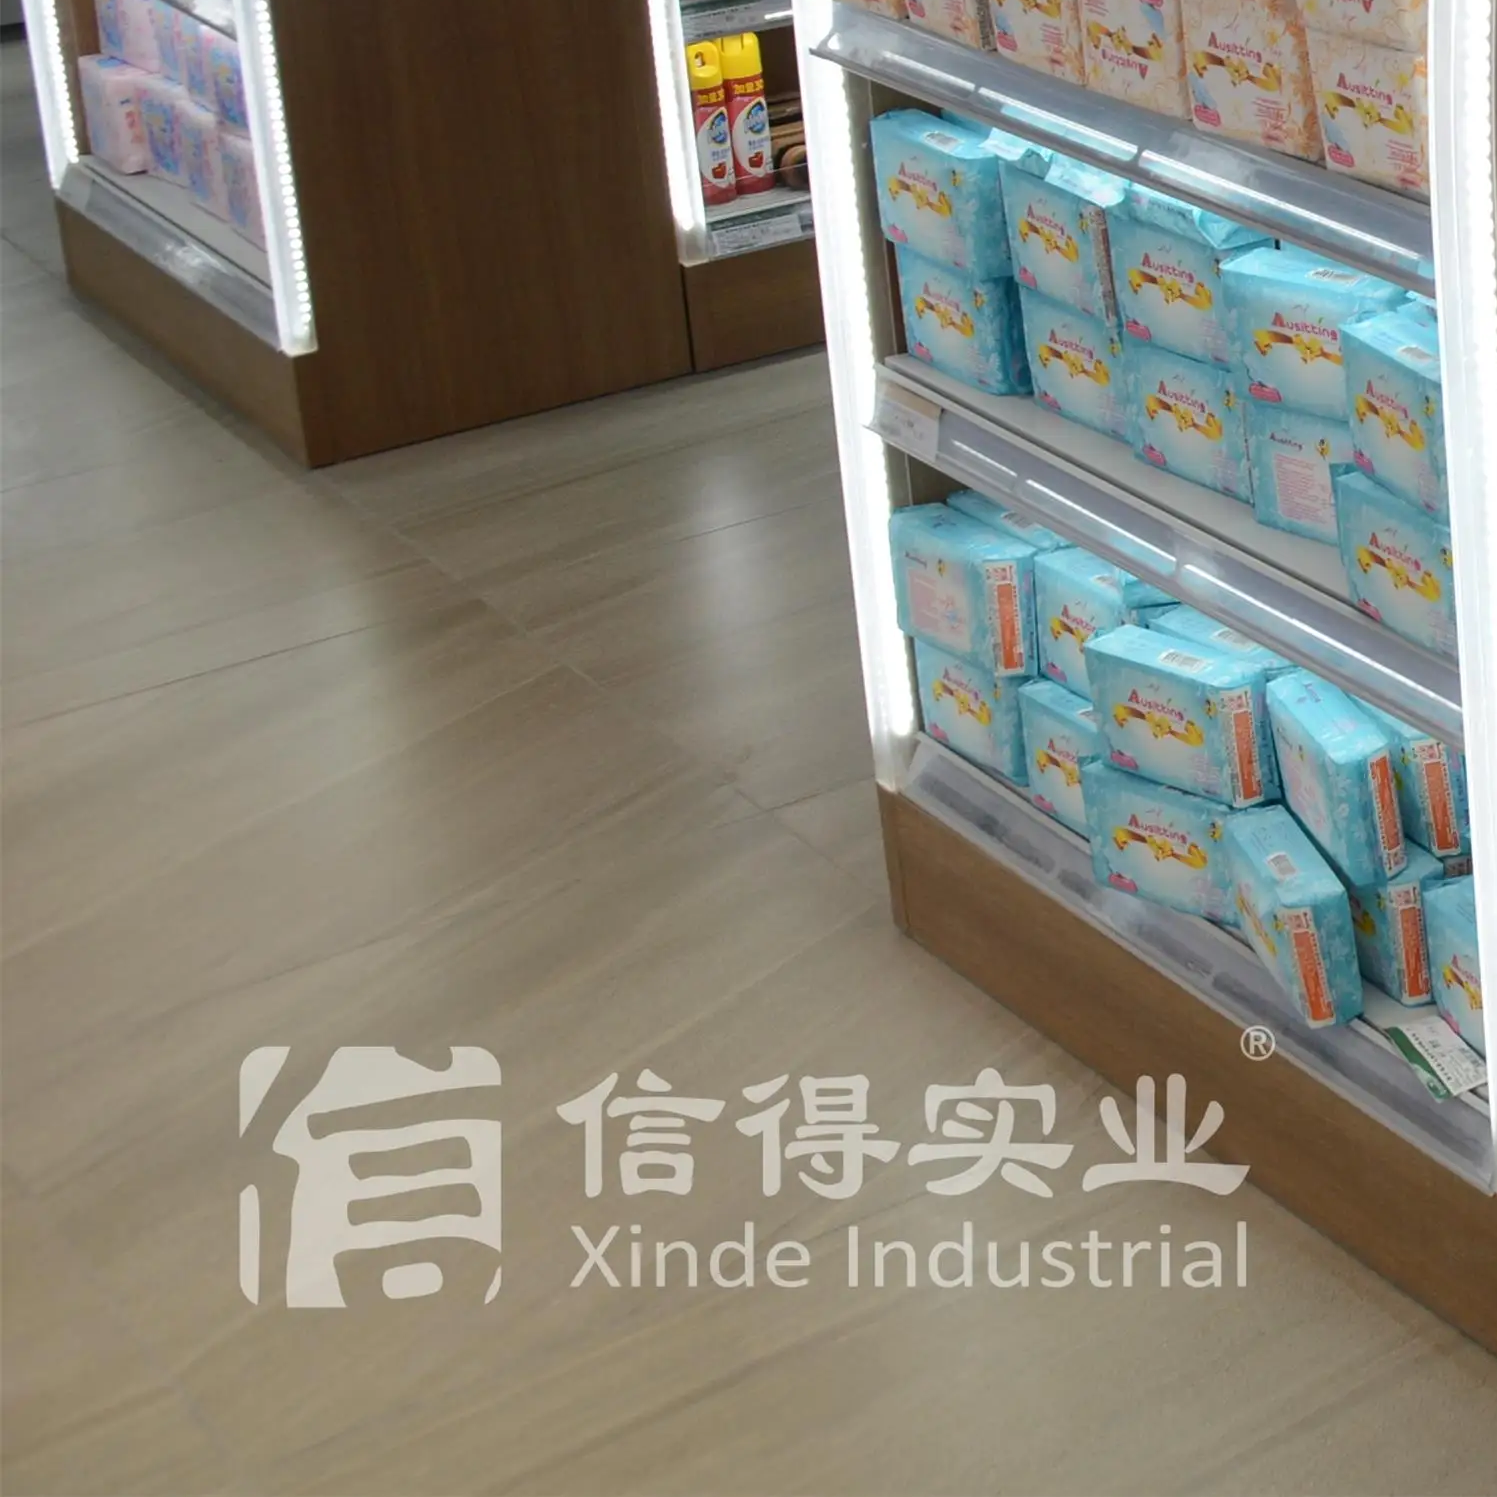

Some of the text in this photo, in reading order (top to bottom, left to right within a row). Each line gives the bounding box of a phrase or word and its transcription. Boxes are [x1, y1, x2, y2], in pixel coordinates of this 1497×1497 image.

[1208, 31, 1263, 63] Ausitting
[1336, 72, 1393, 106] Ausitting
[1141, 252, 1195, 284] Ausitting
[1272, 312, 1339, 341] Ausitting
[1049, 329, 1094, 361] Ausitting
[1158, 380, 1206, 415] Ausitting
[1366, 379, 1409, 420] Ausitting
[1369, 532, 1422, 572] Ausitting
[1128, 688, 1185, 722] Ausitting
[1128, 813, 1188, 845] Ausitting
